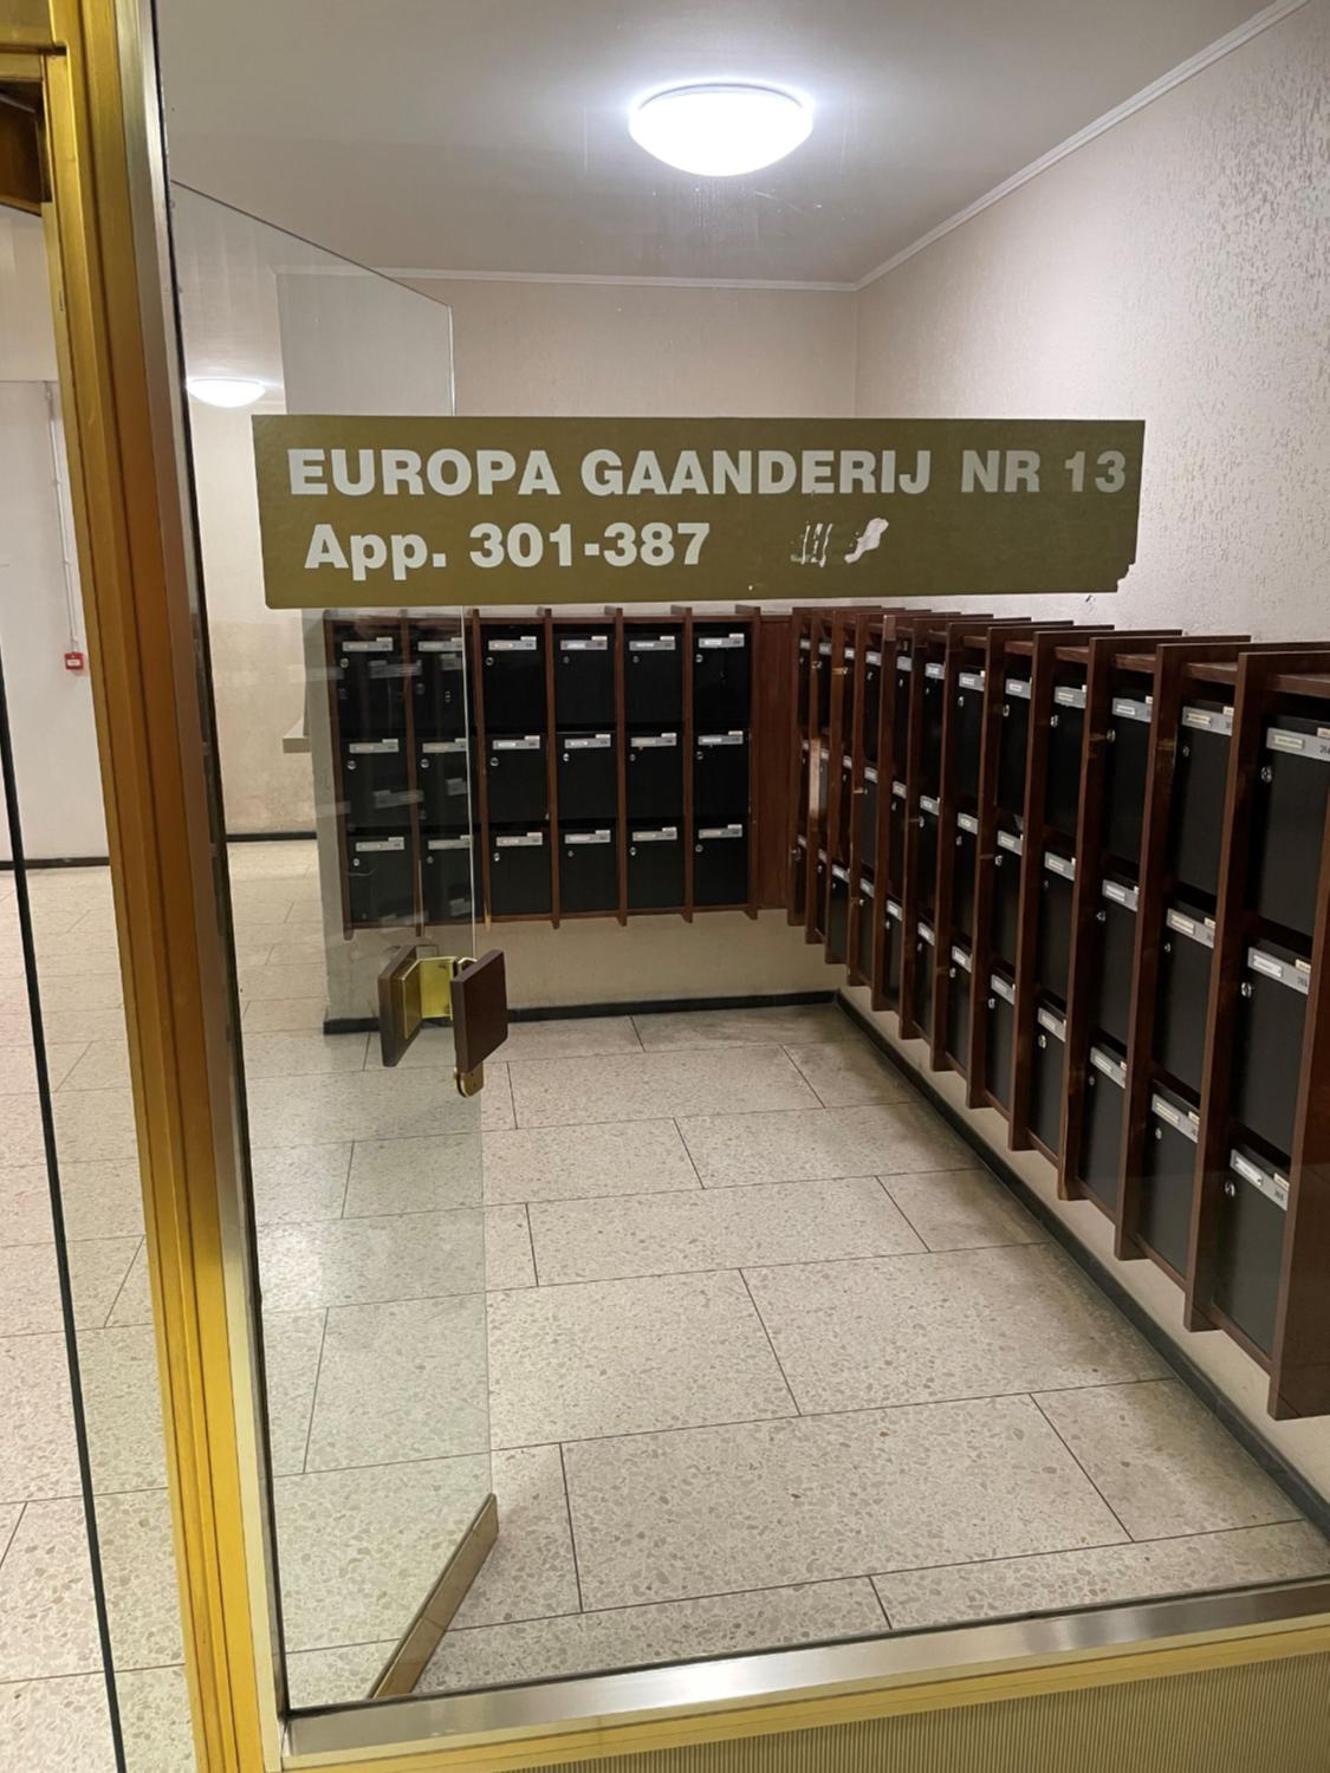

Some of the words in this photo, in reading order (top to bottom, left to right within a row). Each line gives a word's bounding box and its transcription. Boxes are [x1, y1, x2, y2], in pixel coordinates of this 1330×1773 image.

[288, 448, 561, 497] EUROPA
[580, 448, 931, 497] GAANDERIJ
[961, 449, 1041, 493] NR
[1064, 450, 1127, 493] 13
[304, 523, 447, 582] App.
[469, 522, 710, 570] 301-387
